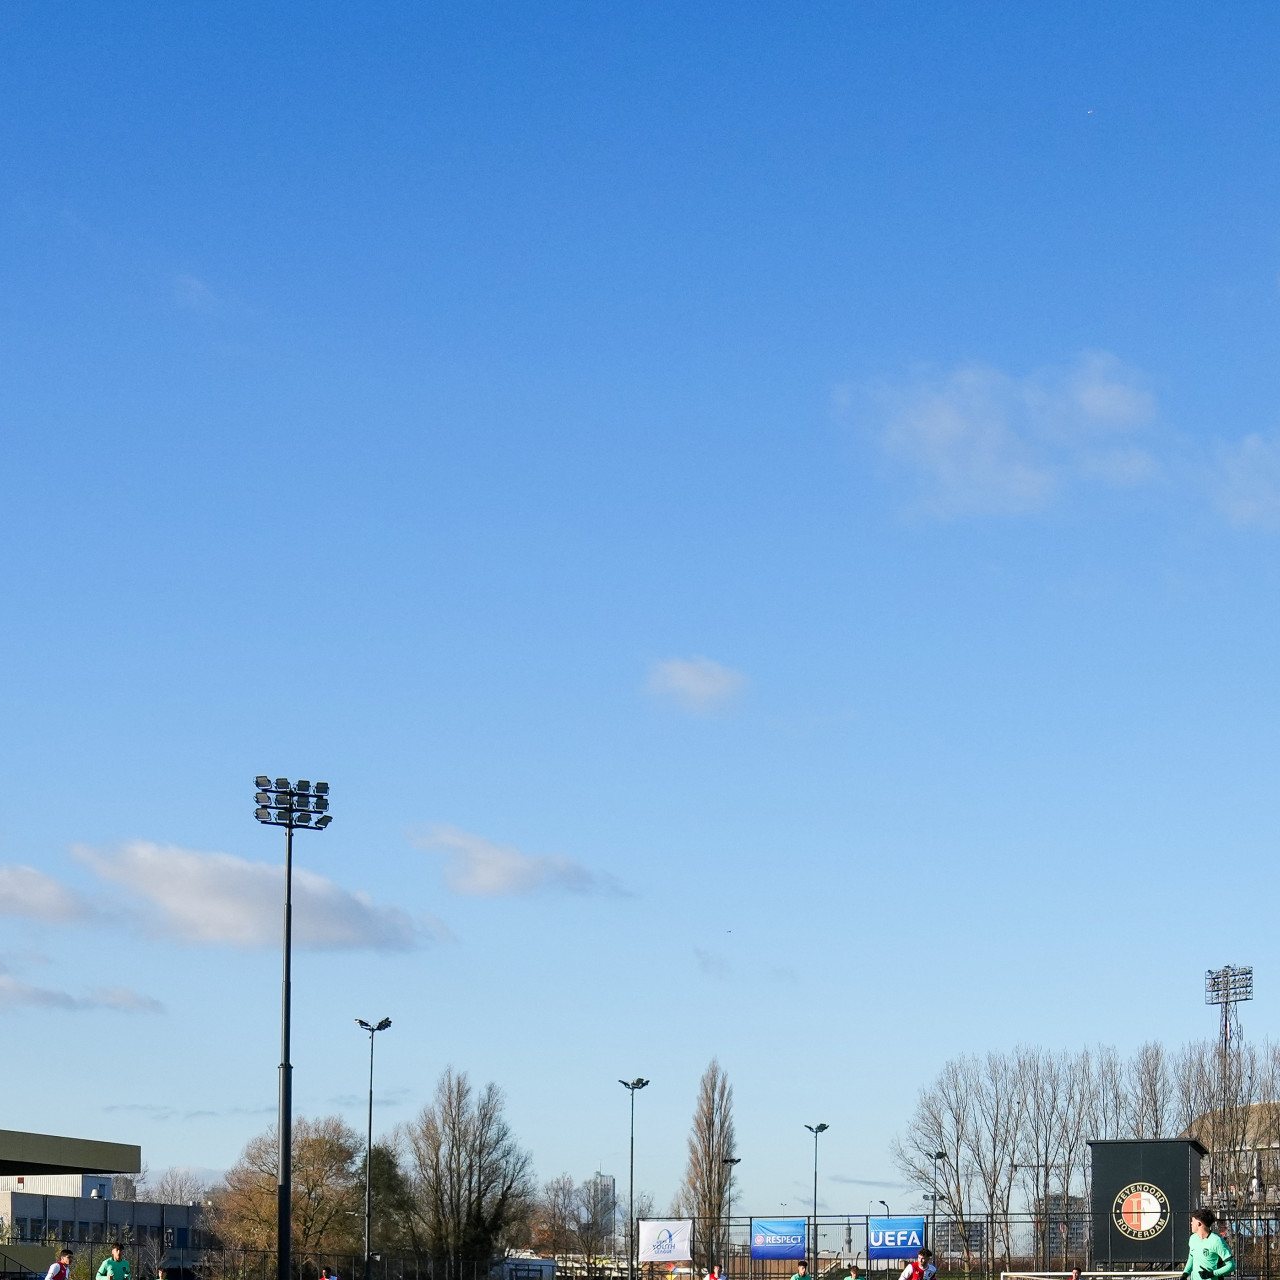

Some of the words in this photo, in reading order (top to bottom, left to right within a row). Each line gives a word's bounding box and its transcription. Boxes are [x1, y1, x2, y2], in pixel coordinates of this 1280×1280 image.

[1117, 1185, 1165, 1204] FEYENOORD
[1117, 1219, 1166, 1238] ROTTERDAM
[765, 1235, 803, 1244] RESPECT
[870, 1231, 921, 1246] UEFA
